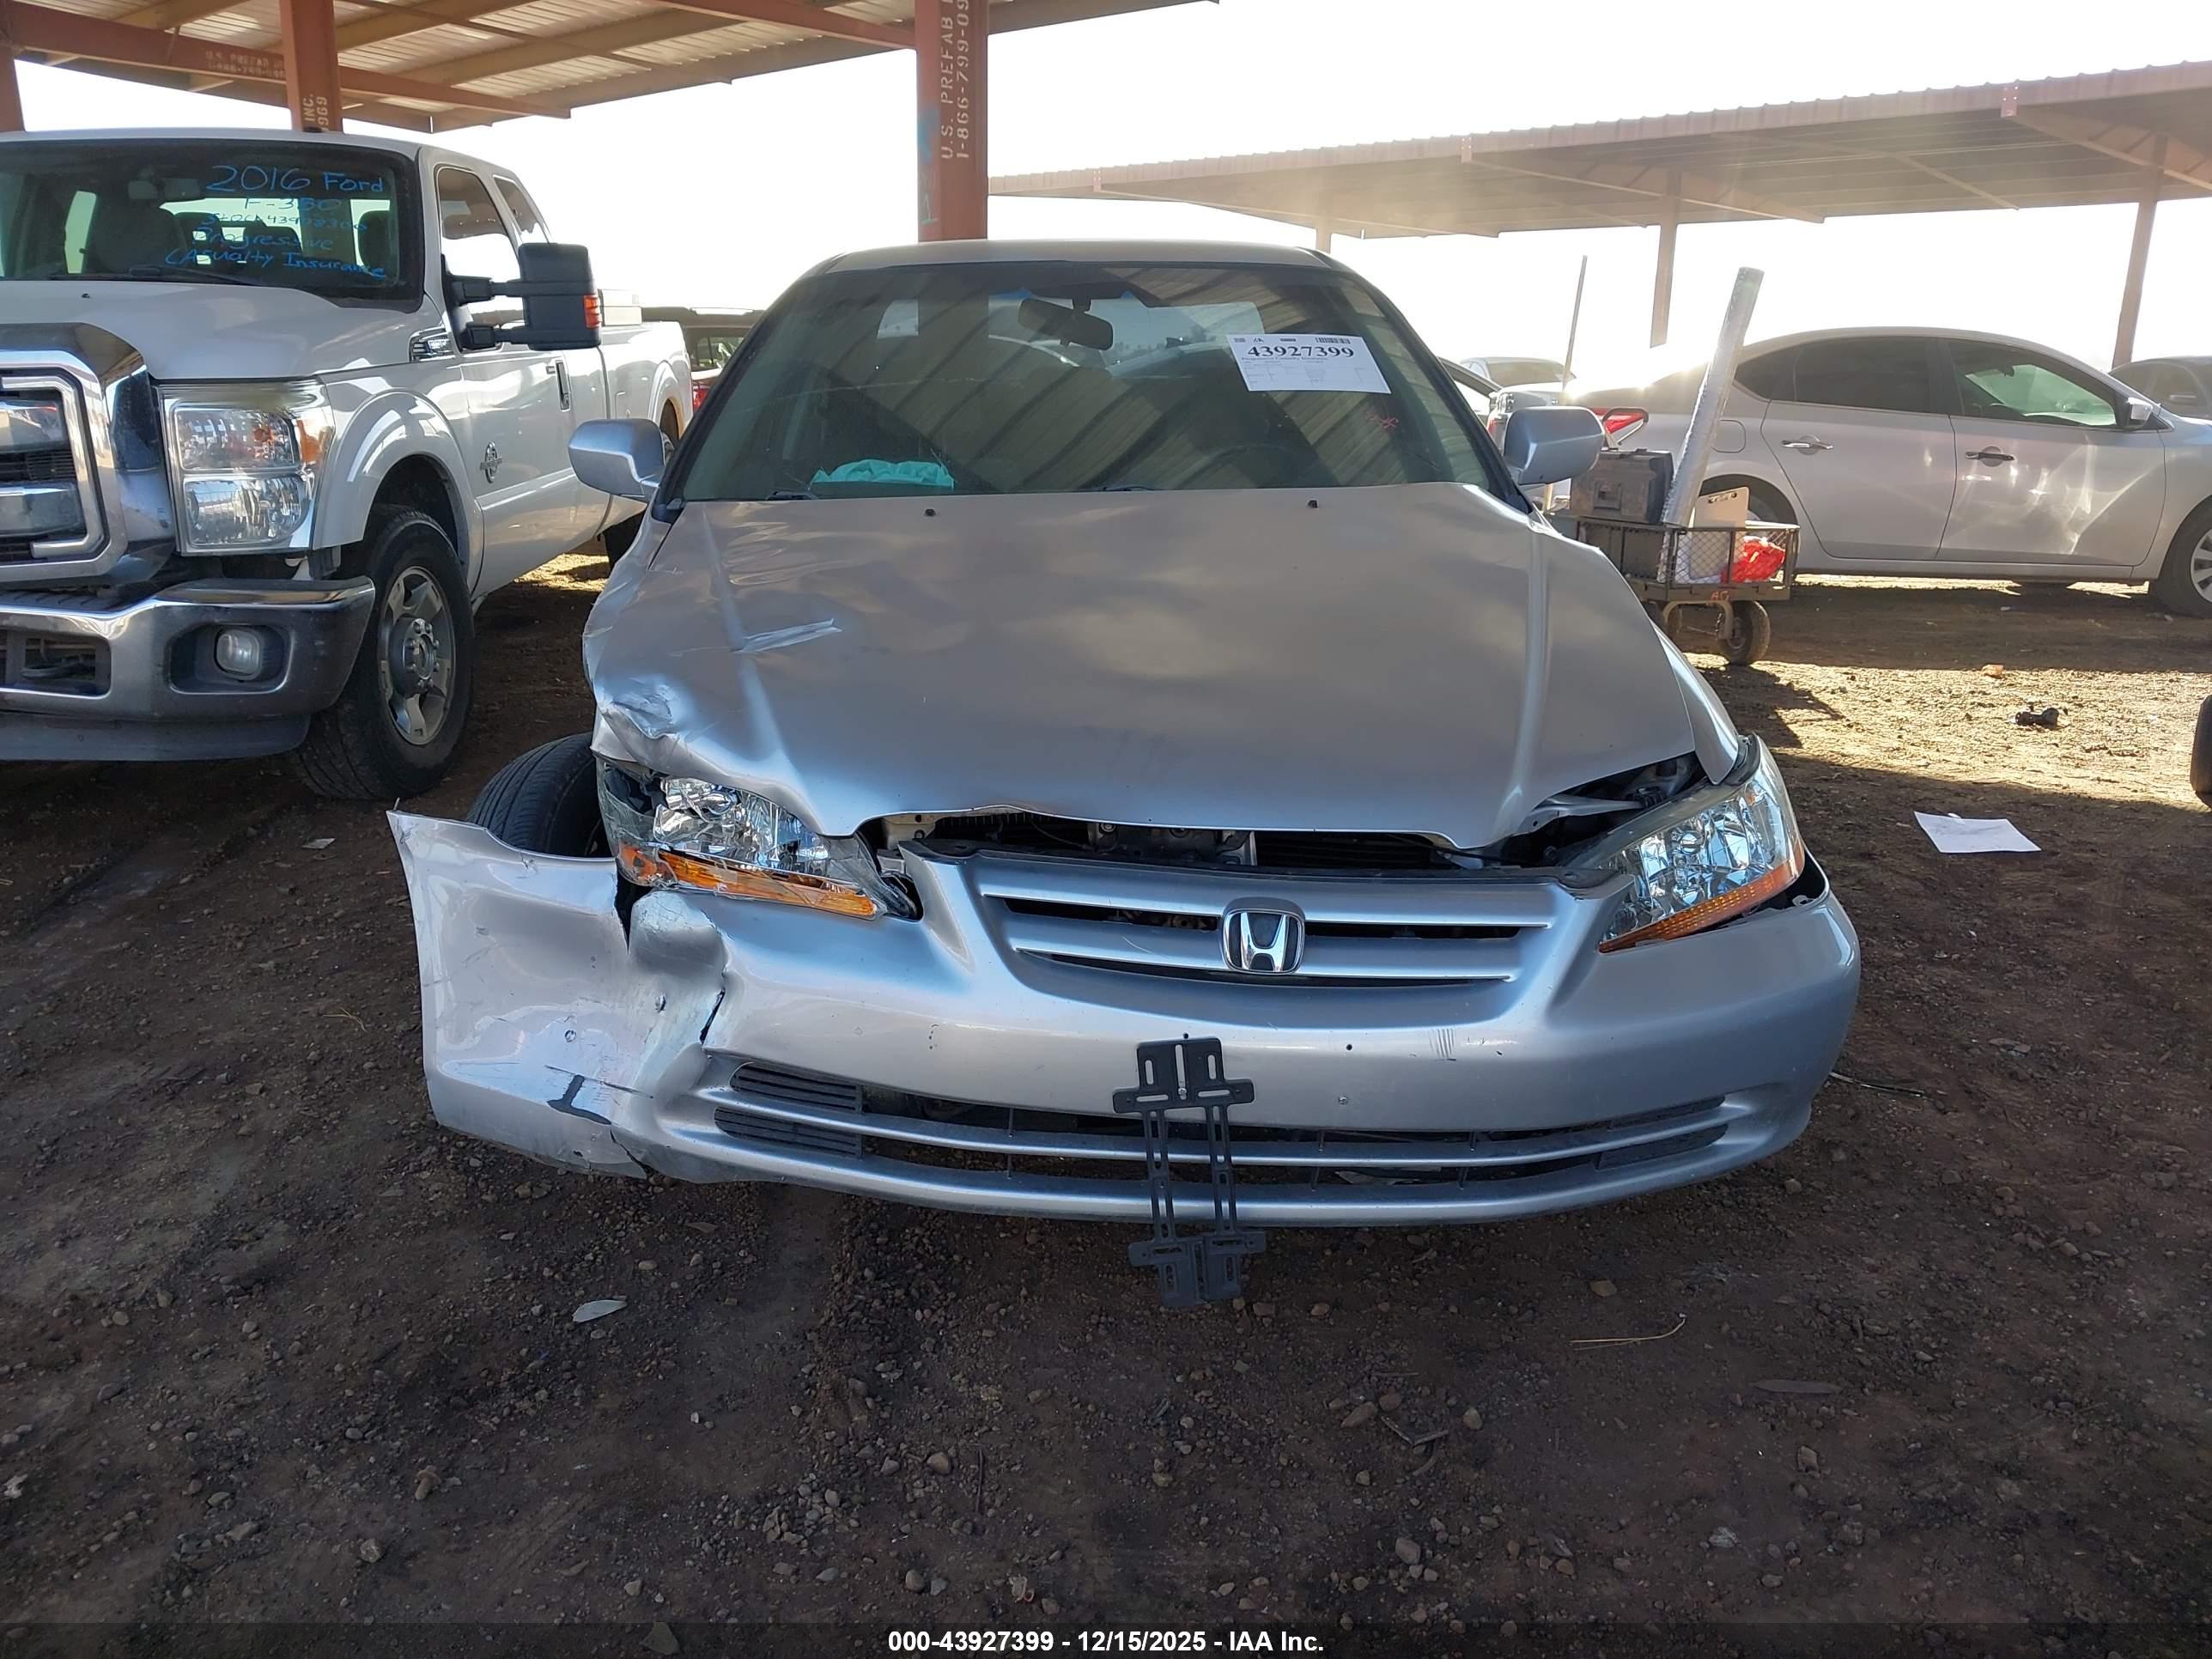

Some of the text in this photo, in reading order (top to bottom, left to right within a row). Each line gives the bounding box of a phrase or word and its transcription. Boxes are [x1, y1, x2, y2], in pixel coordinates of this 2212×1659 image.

[940, 16, 953, 104] PREFAB
[302, 94, 316, 122] INC.
[940, 118, 953, 159] U.S.
[206, 165, 384, 192] 2016 Ford
[192, 227, 333, 249] Progressve
[1248, 346, 1354, 357] 43927399
